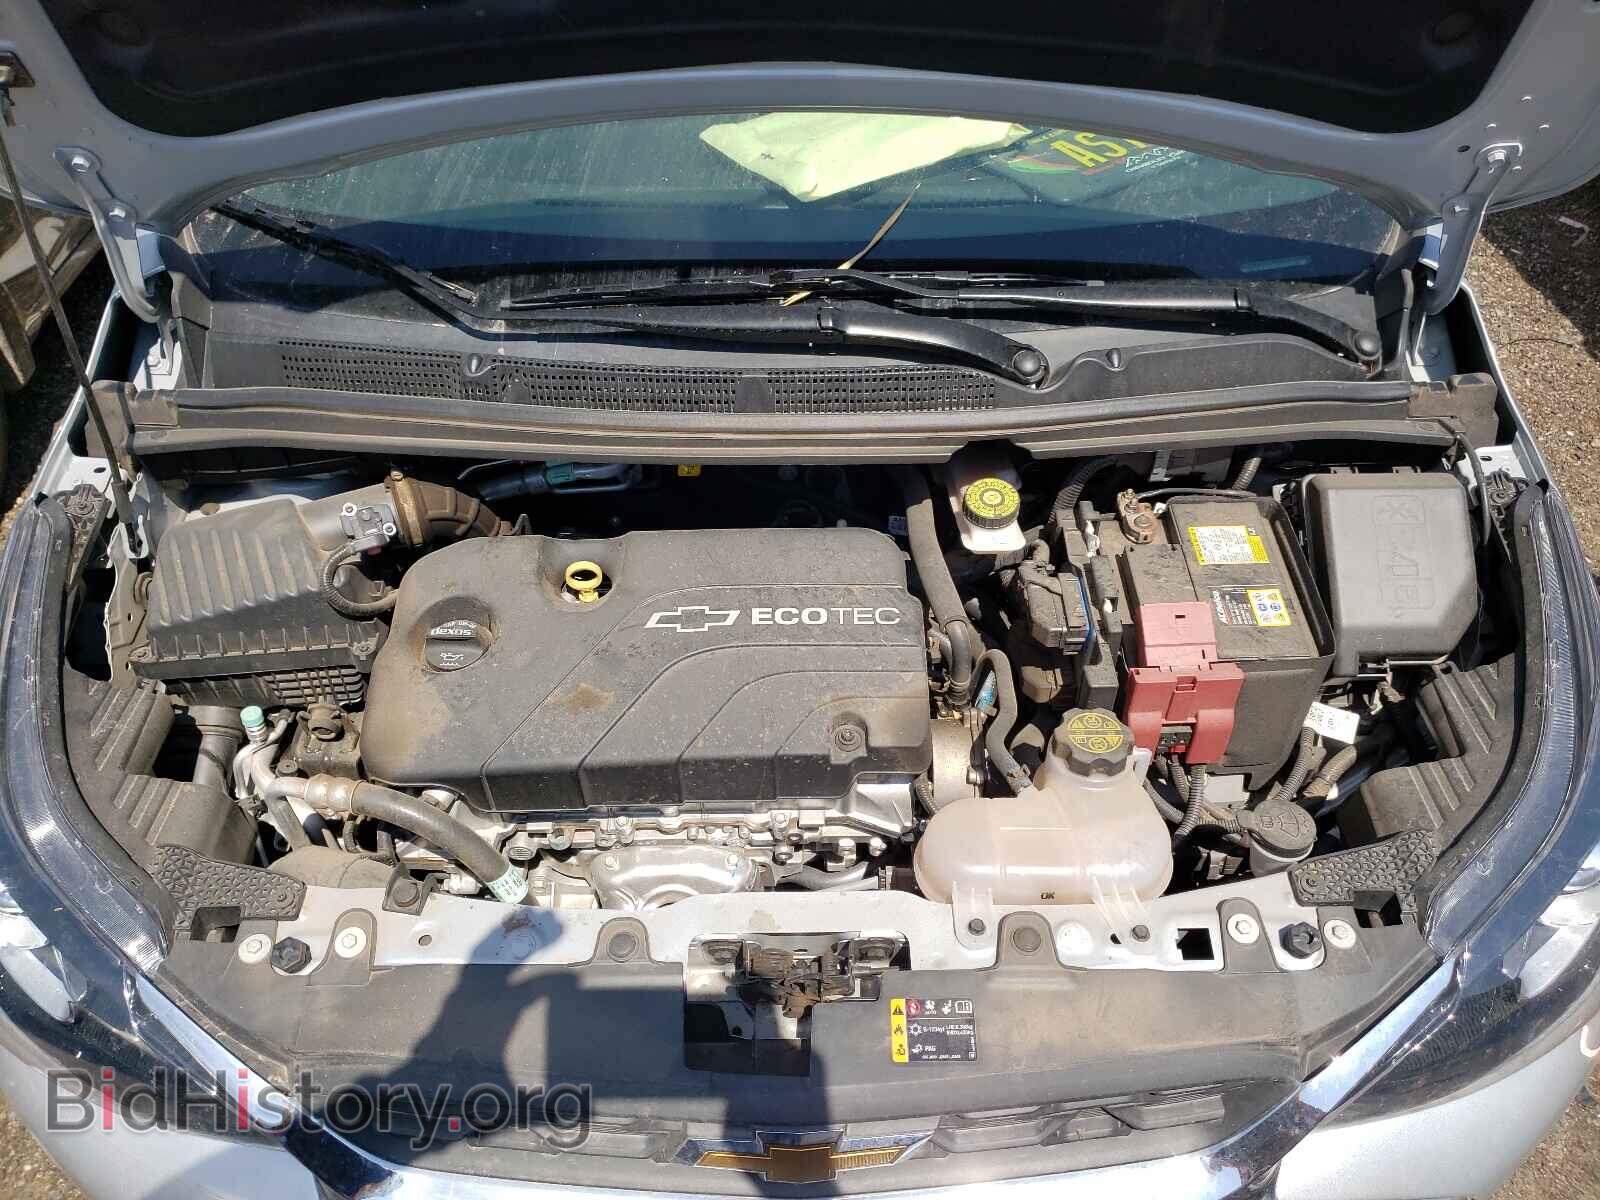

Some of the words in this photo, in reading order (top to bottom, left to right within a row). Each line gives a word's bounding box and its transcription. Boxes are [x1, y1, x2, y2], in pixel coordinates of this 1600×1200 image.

[1050, 131, 1147, 168] AS
[751, 608, 900, 625] ECOTEC
[431, 626, 473, 636] dexos
